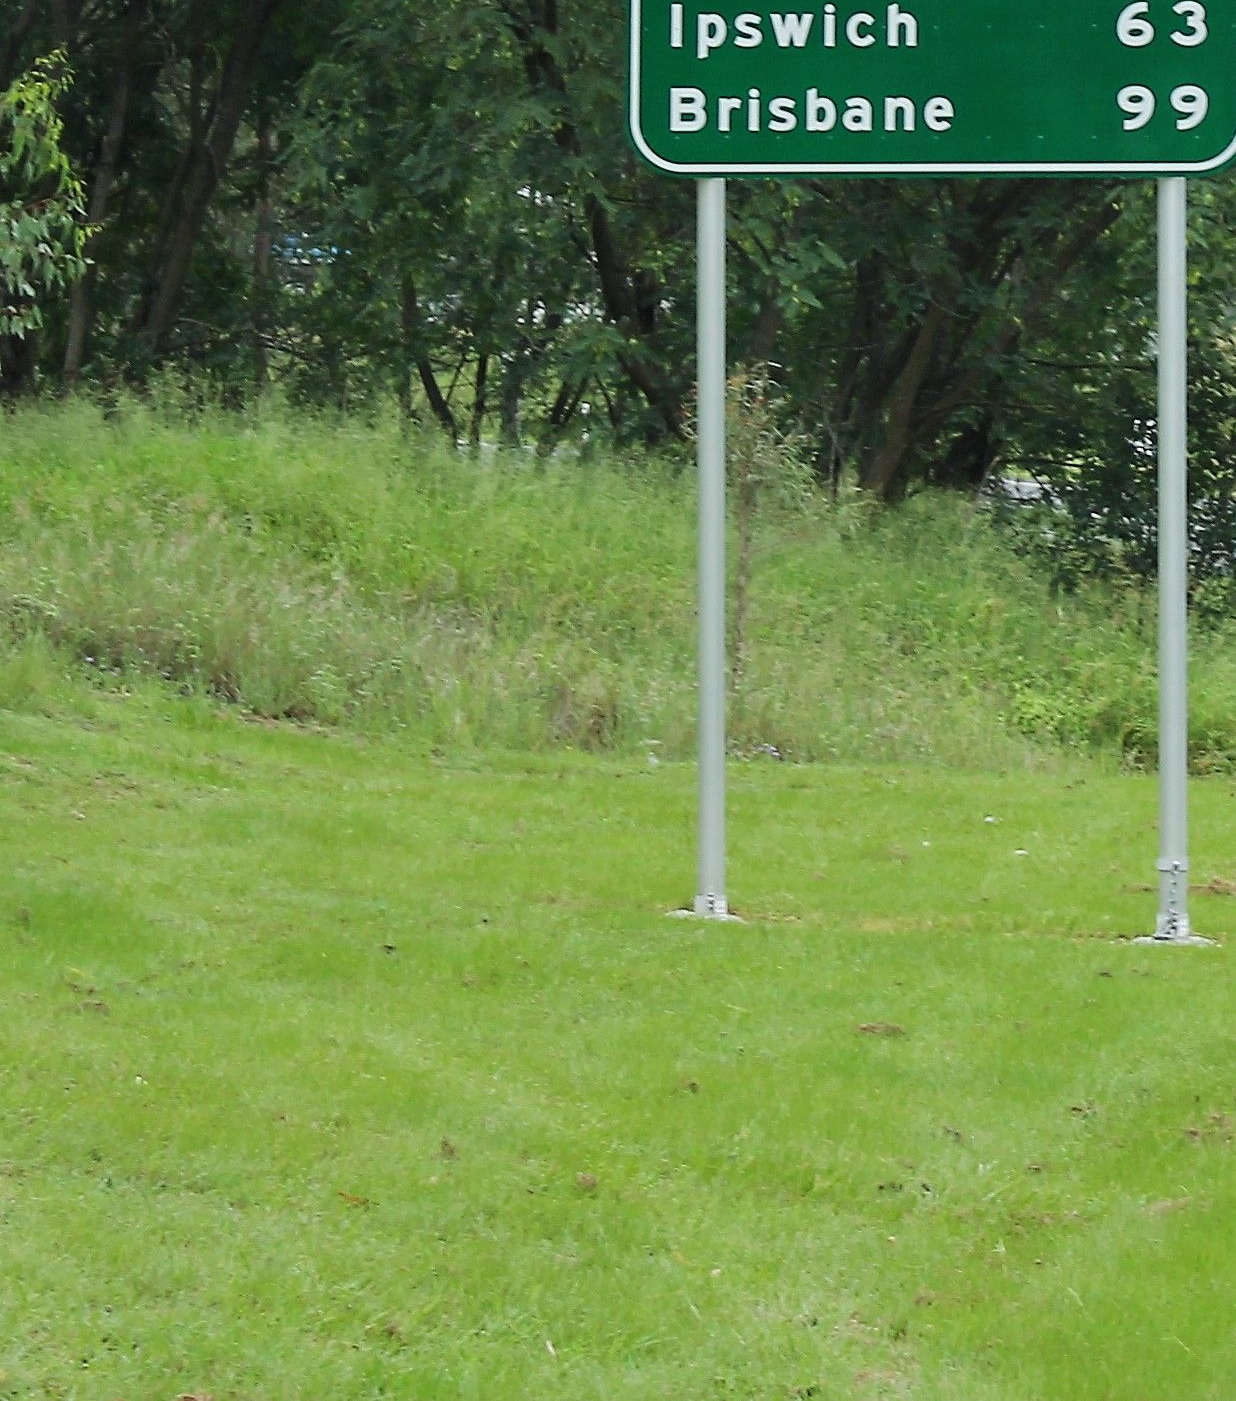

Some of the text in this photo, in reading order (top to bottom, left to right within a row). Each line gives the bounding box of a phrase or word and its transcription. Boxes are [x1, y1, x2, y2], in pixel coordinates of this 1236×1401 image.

[669, 0, 1209, 59] Ipswich 63
[668, 84, 1210, 132] Brisbane 99
